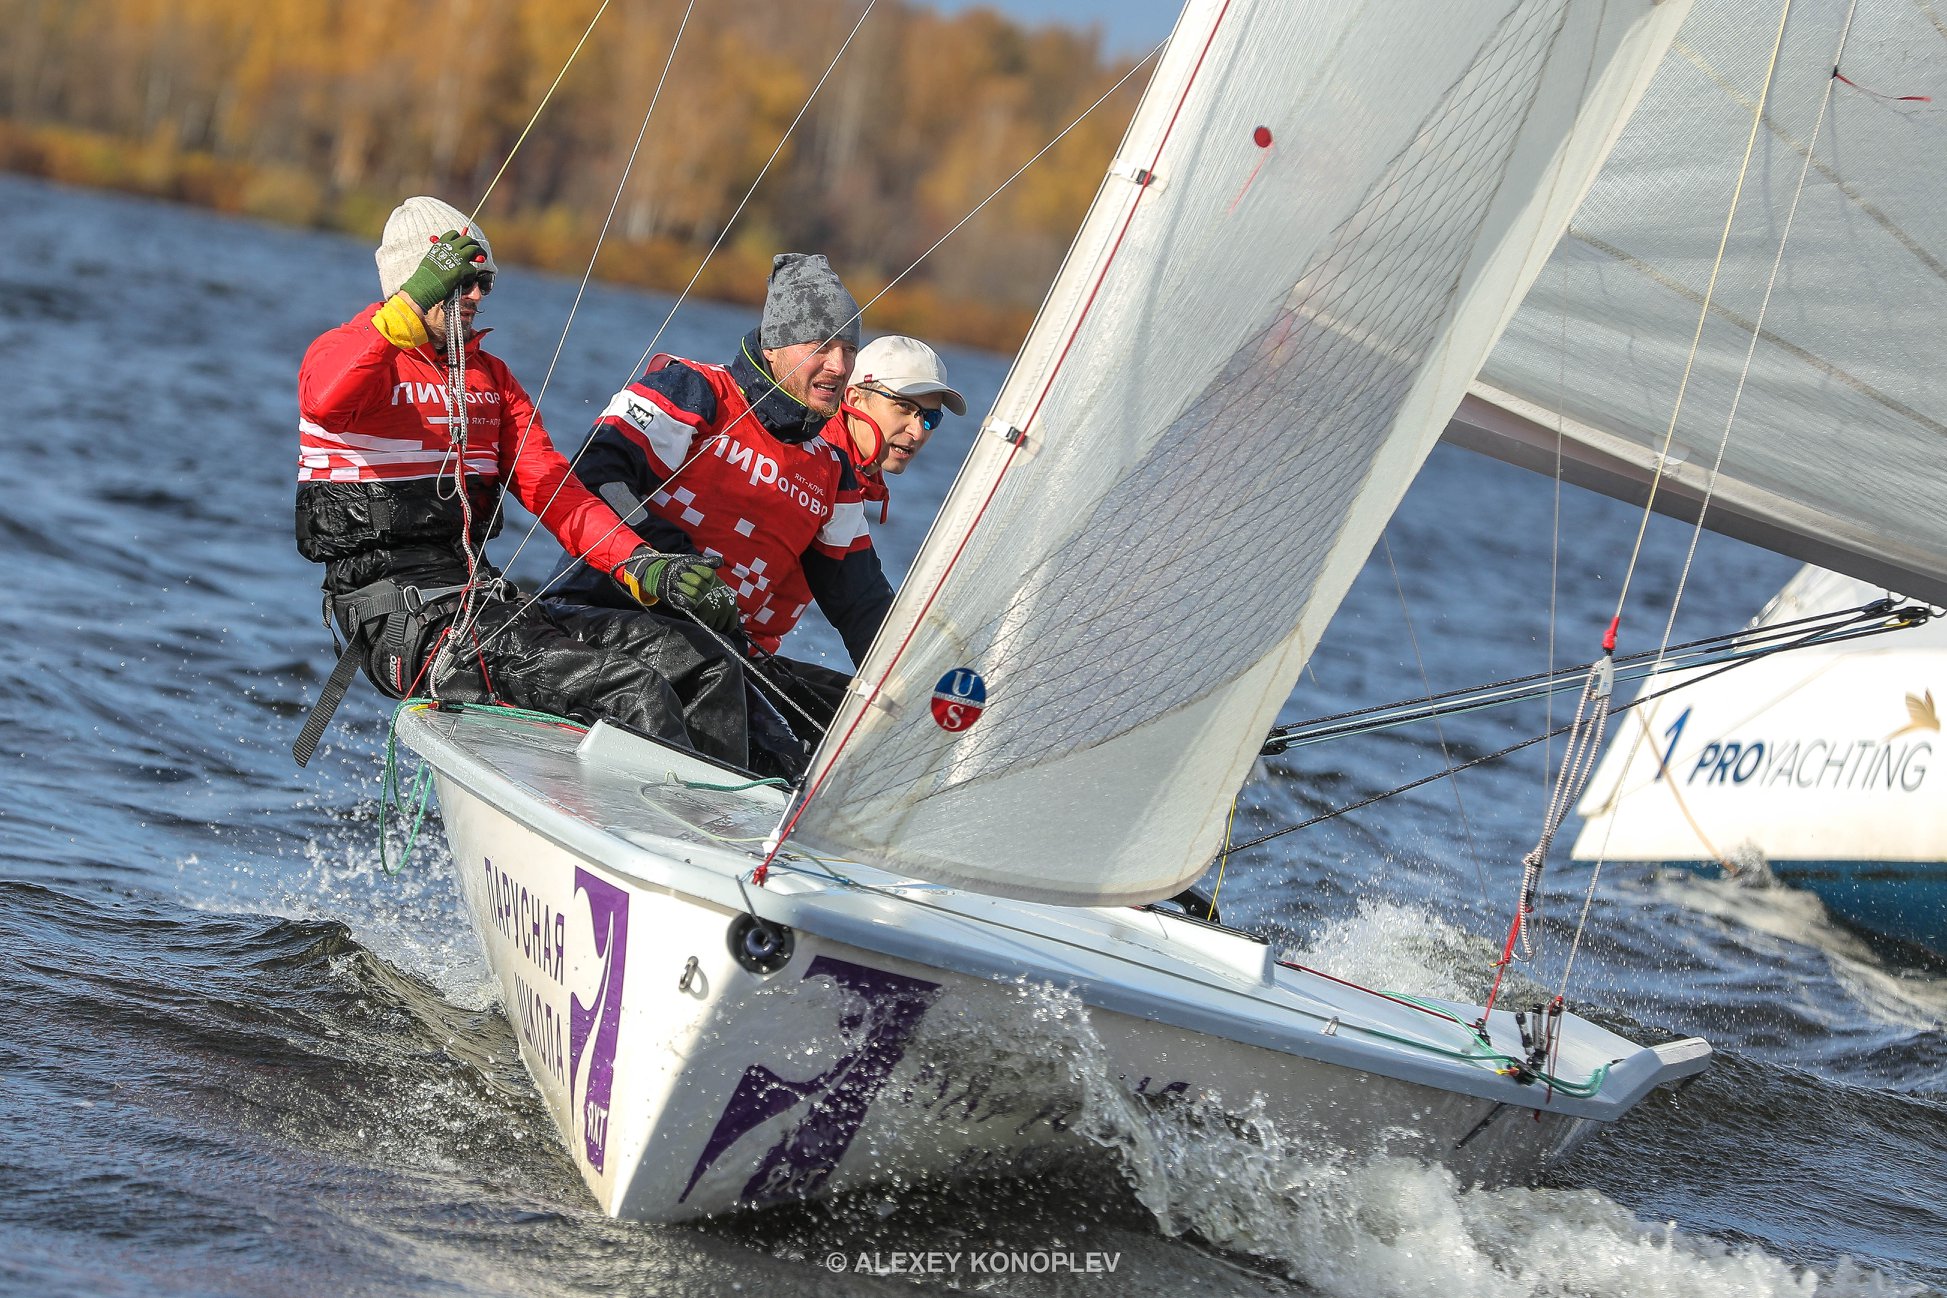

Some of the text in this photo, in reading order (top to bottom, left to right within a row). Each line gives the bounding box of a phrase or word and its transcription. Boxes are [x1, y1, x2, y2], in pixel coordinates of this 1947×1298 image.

[389, 654, 399, 690] MUSTO
[1653, 704, 1693, 785] 1
[484, 856, 565, 986] ПАРУСНАЯ
[514, 972, 566, 1087] ШКОЛА
